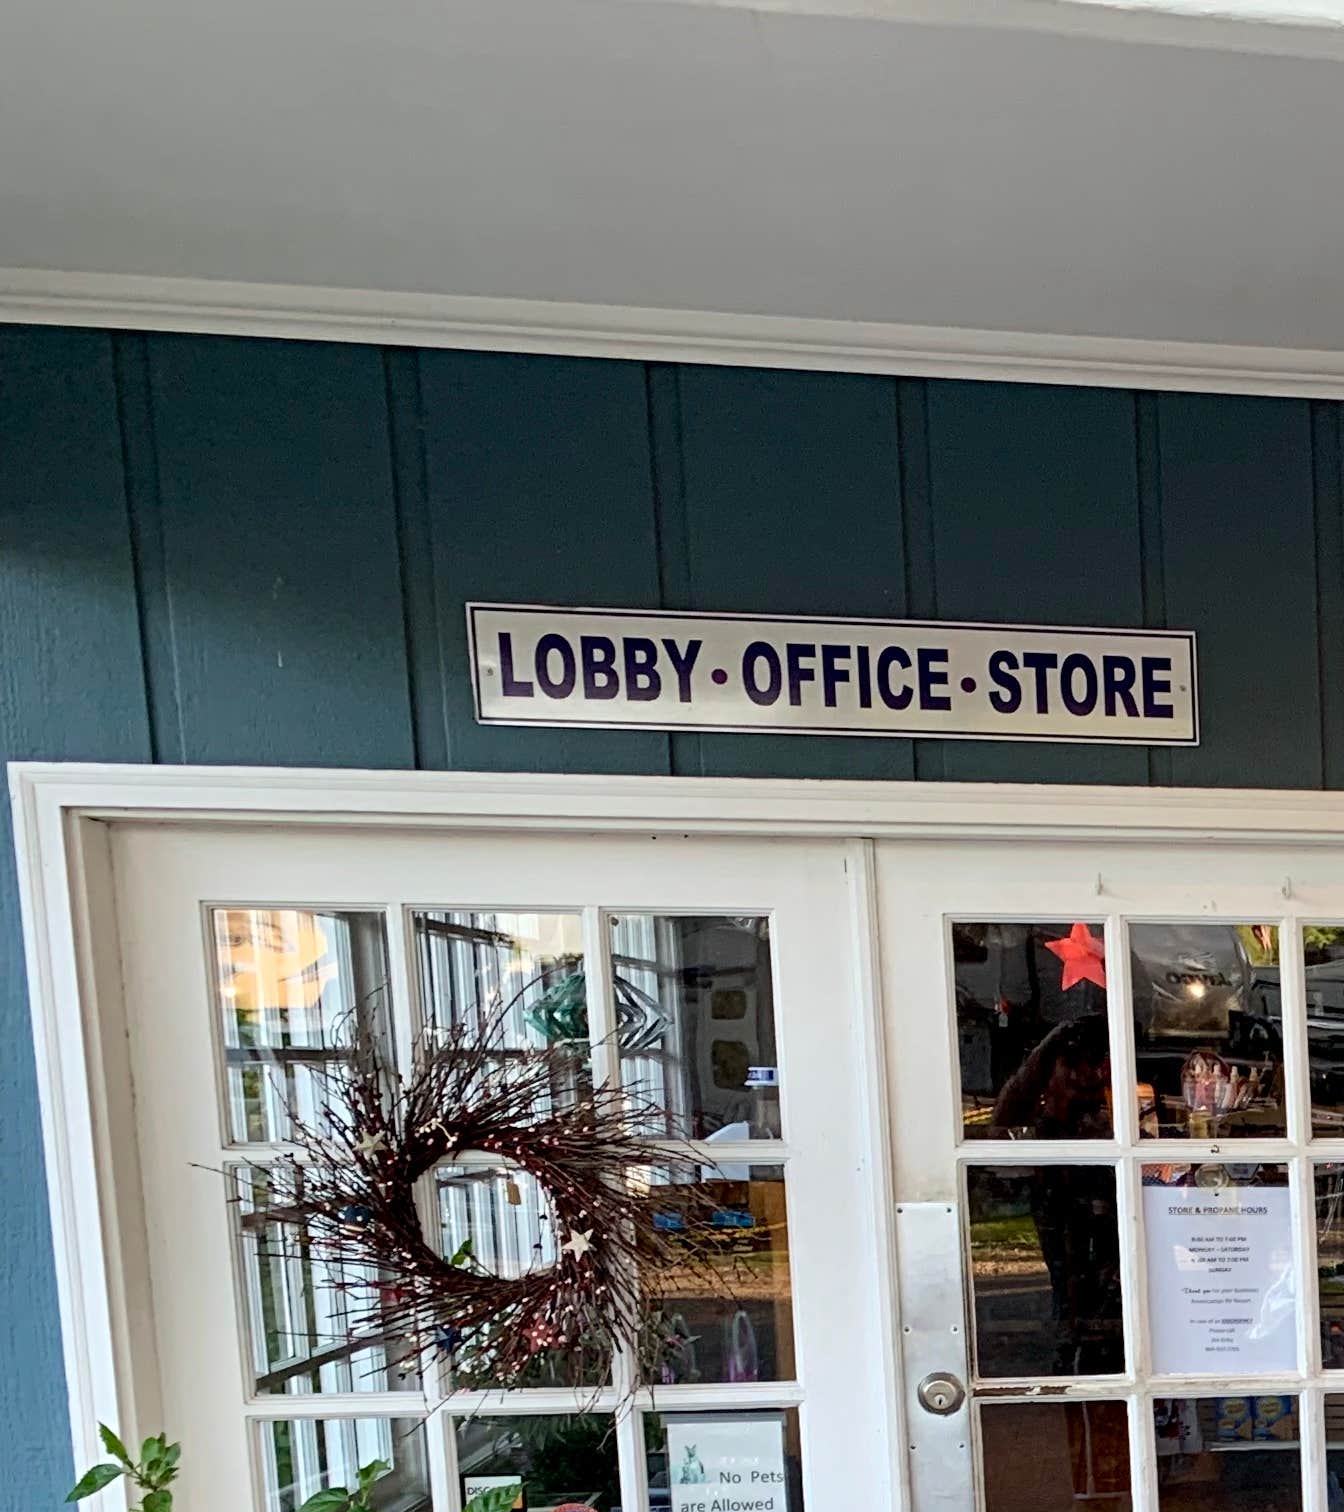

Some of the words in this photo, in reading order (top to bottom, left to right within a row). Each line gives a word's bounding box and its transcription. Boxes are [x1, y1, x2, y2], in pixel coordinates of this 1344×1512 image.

[497, 631, 702, 703] LOBBY
[741, 640, 952, 711] OFFICE
[988, 649, 1175, 719] STORE
[1168, 1206, 1193, 1215] STORE
[1240, 1206, 1268, 1215] HOURS
[718, 1470, 743, 1485] No
[750, 1470, 785, 1484] Pets
[680, 1500, 706, 1512] are
[710, 1497, 775, 1512] Allowed
